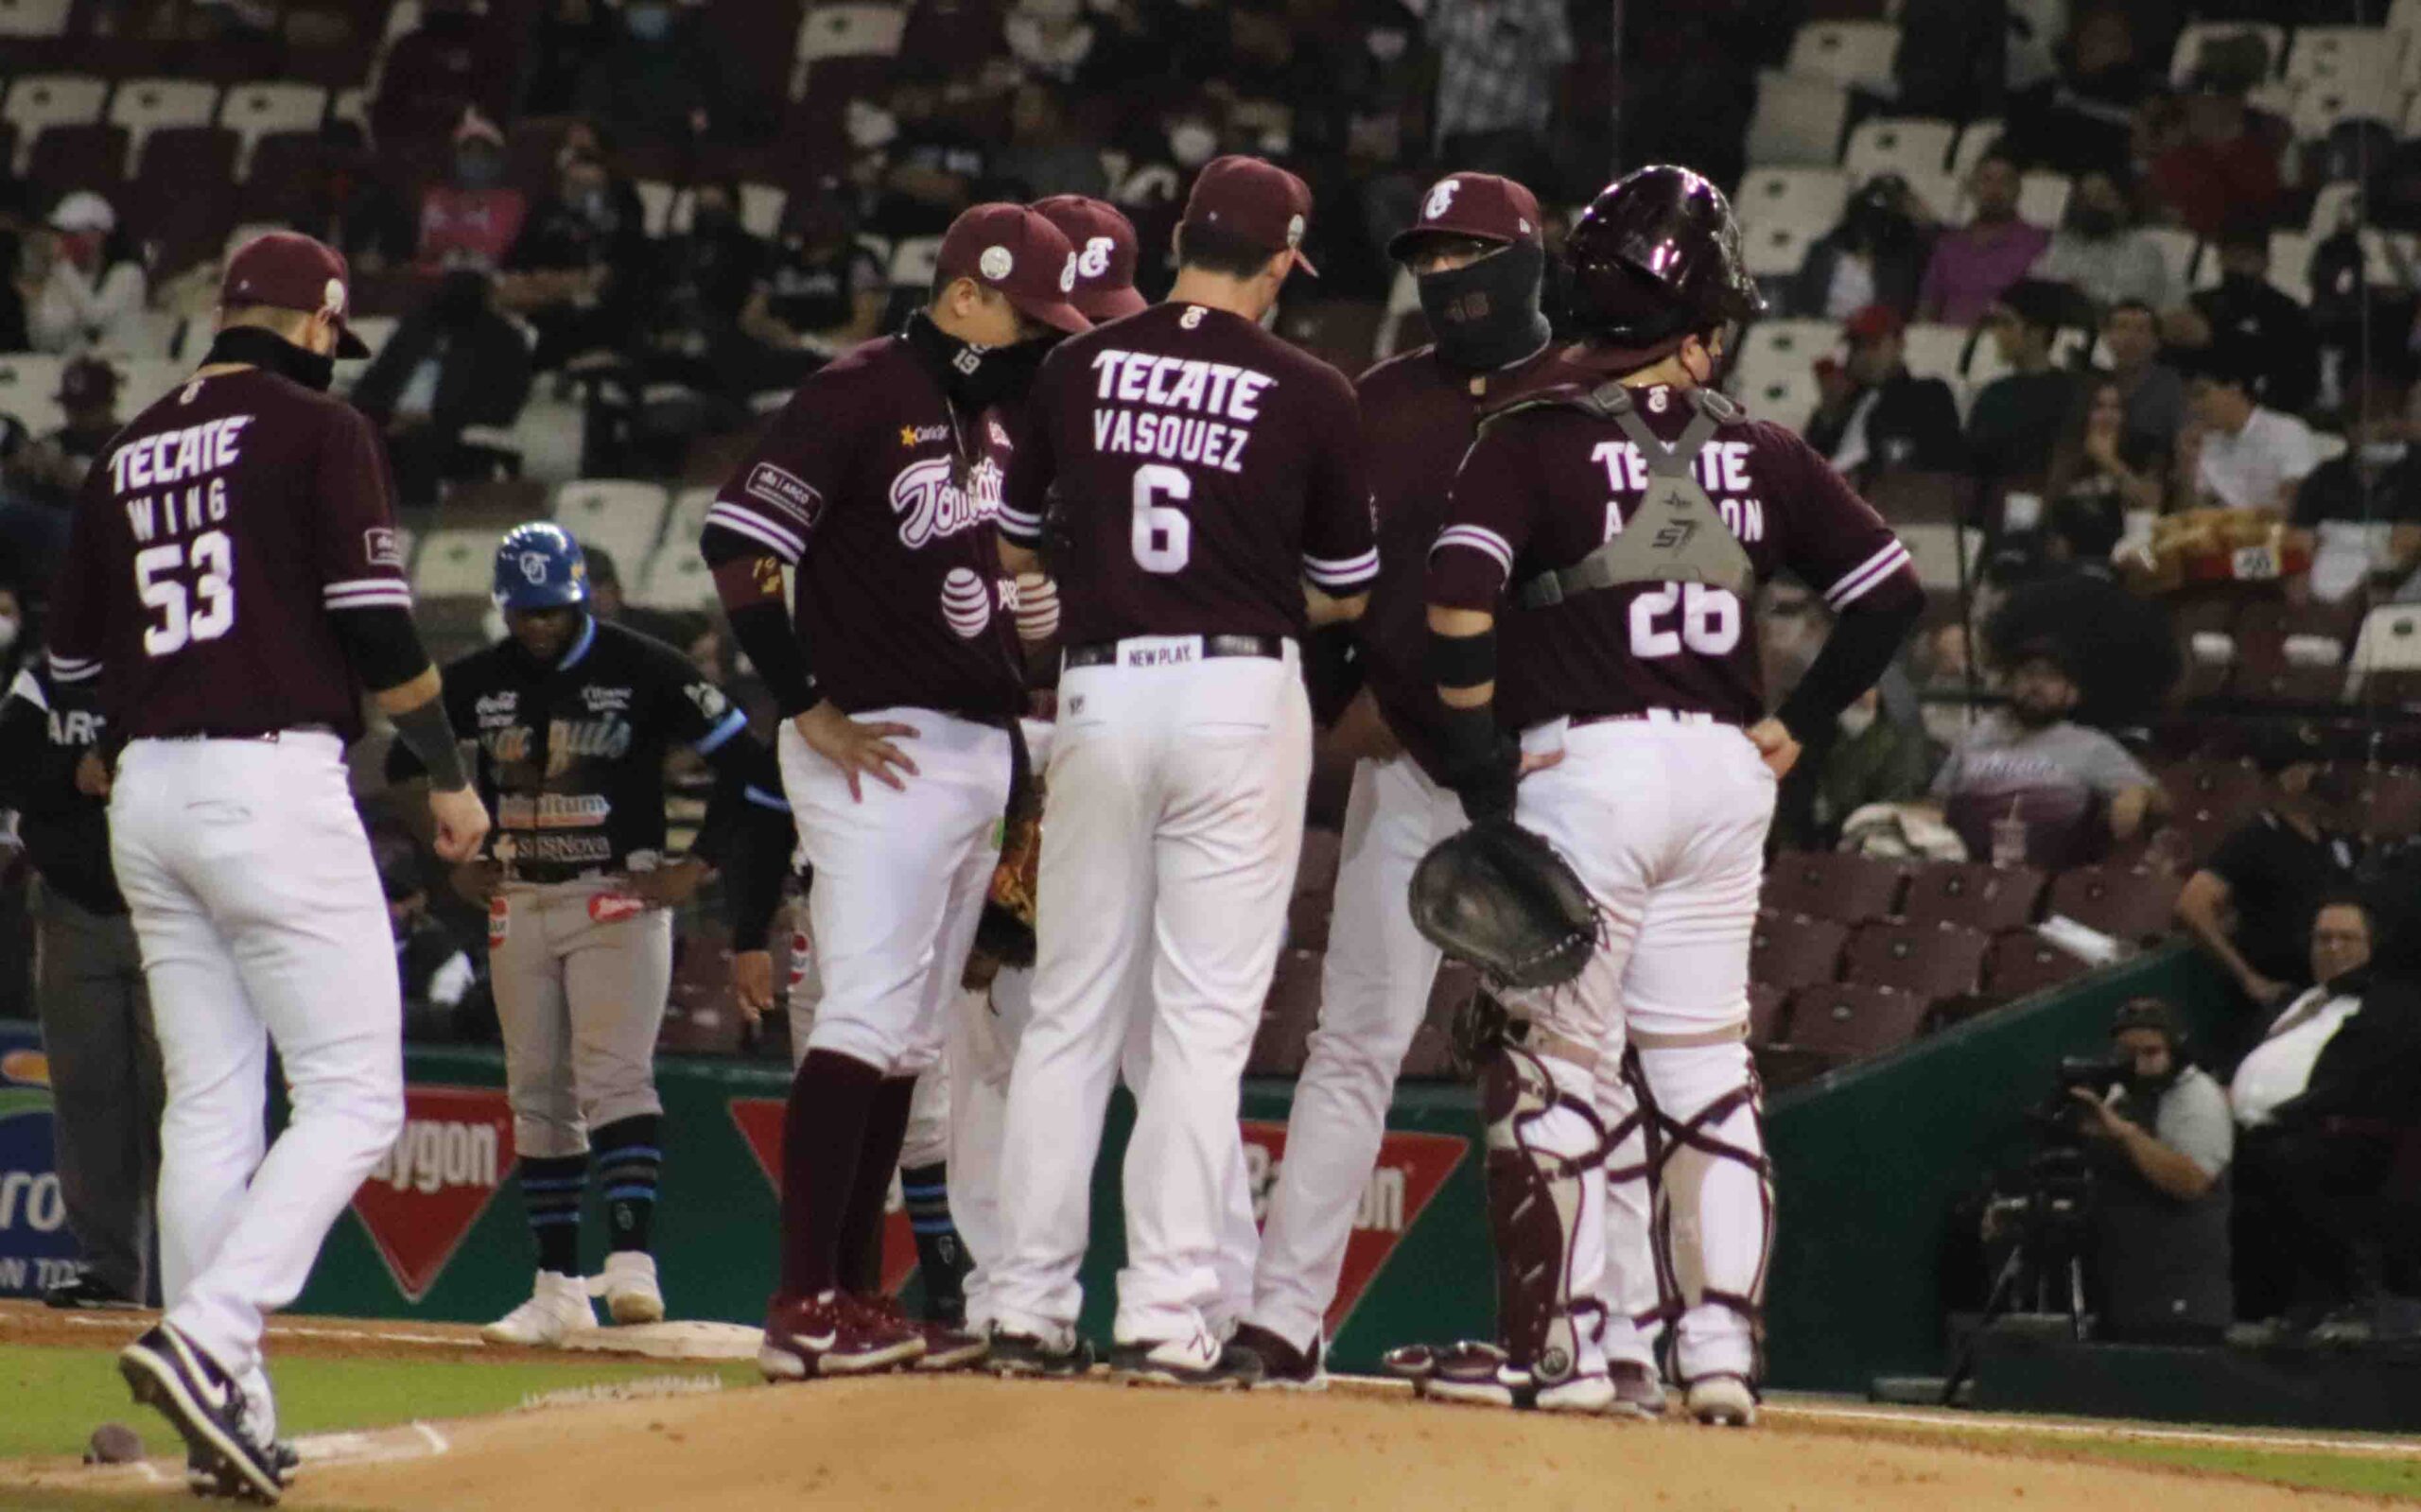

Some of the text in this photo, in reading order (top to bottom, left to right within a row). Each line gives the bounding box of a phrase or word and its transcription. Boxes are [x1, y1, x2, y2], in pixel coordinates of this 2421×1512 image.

[1090, 349, 1277, 423] TECATE
[106, 413, 255, 496] TECATE
[1093, 408, 1249, 473] VASQUEZ
[1591, 441, 1751, 492] TETE
[126, 476, 227, 542] WING
[1131, 463, 1191, 574] 6
[134, 530, 235, 657] 53
[1629, 581, 1741, 657] 26
[1128, 649, 1157, 668] NEW
